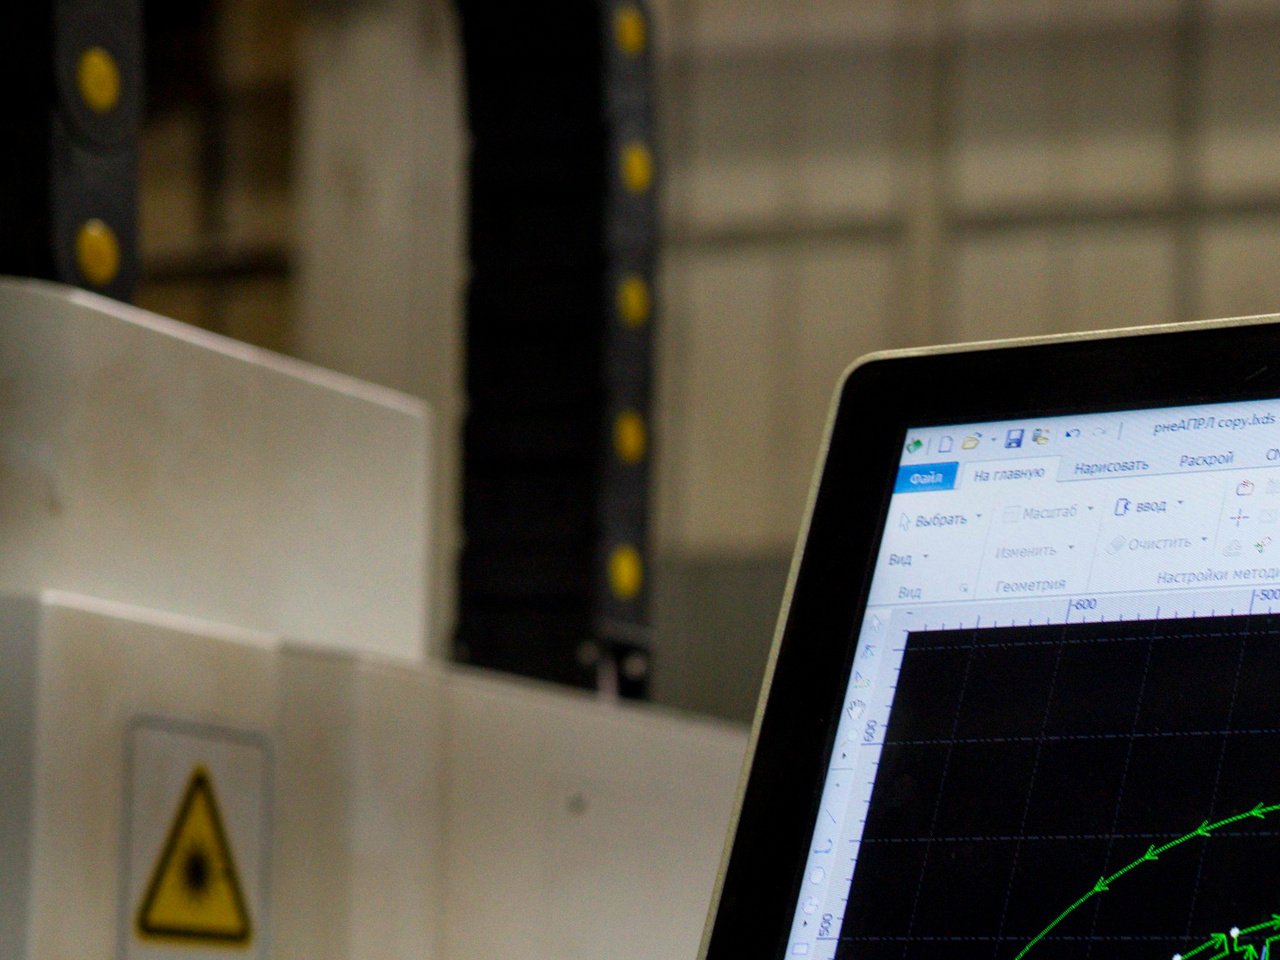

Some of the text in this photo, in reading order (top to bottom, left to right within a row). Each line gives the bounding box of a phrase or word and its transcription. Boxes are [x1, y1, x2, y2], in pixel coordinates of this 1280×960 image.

[1074, 458, 1149, 476] Нарисовать
[1180, 449, 1234, 468] Раскрой
[910, 470, 944, 487] Файл
[974, 466, 1045, 483] На главную
[1023, 504, 1077, 521] Масштаб
[1136, 500, 1167, 515] ввод
[916, 511, 968, 529] Выбрать
[995, 542, 1057, 560] Изменить
[1128, 536, 1192, 552] Очистить
[889, 551, 912, 569] Вид
[1157, 567, 1229, 586] Настройки
[899, 585, 922, 601] Вид
[995, 577, 1066, 595] Геометрия
[819, 913, 834, 938] 500
